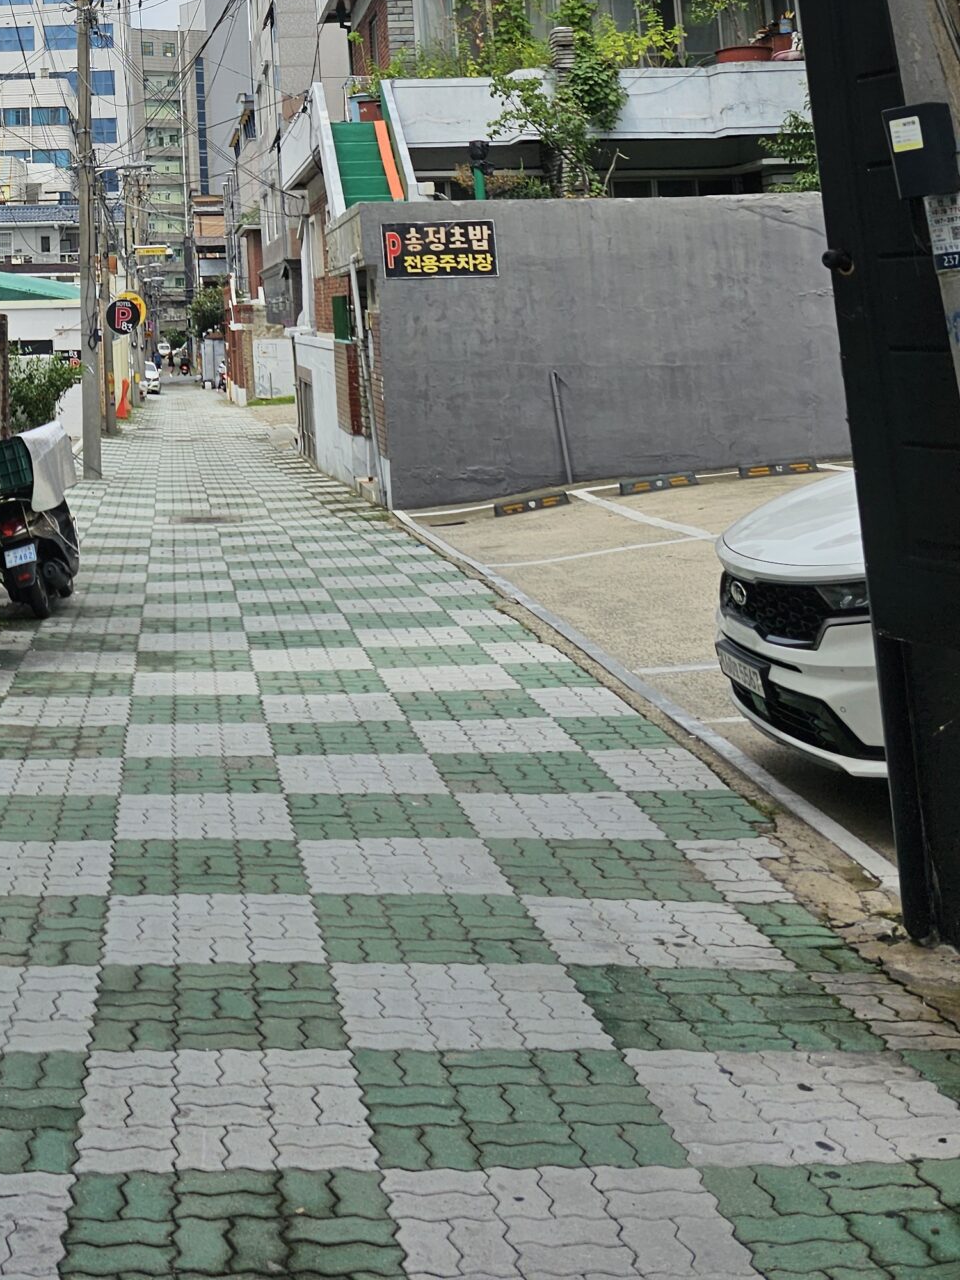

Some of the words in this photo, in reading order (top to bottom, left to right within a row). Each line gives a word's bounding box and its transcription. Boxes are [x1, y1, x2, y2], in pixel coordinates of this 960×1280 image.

[404, 225, 492, 252] 송정초밥
[386, 232, 402, 268] P
[404, 253, 493, 273] 전용주차장
[115, 307, 133, 329] P
[122, 322, 133, 332] 83
